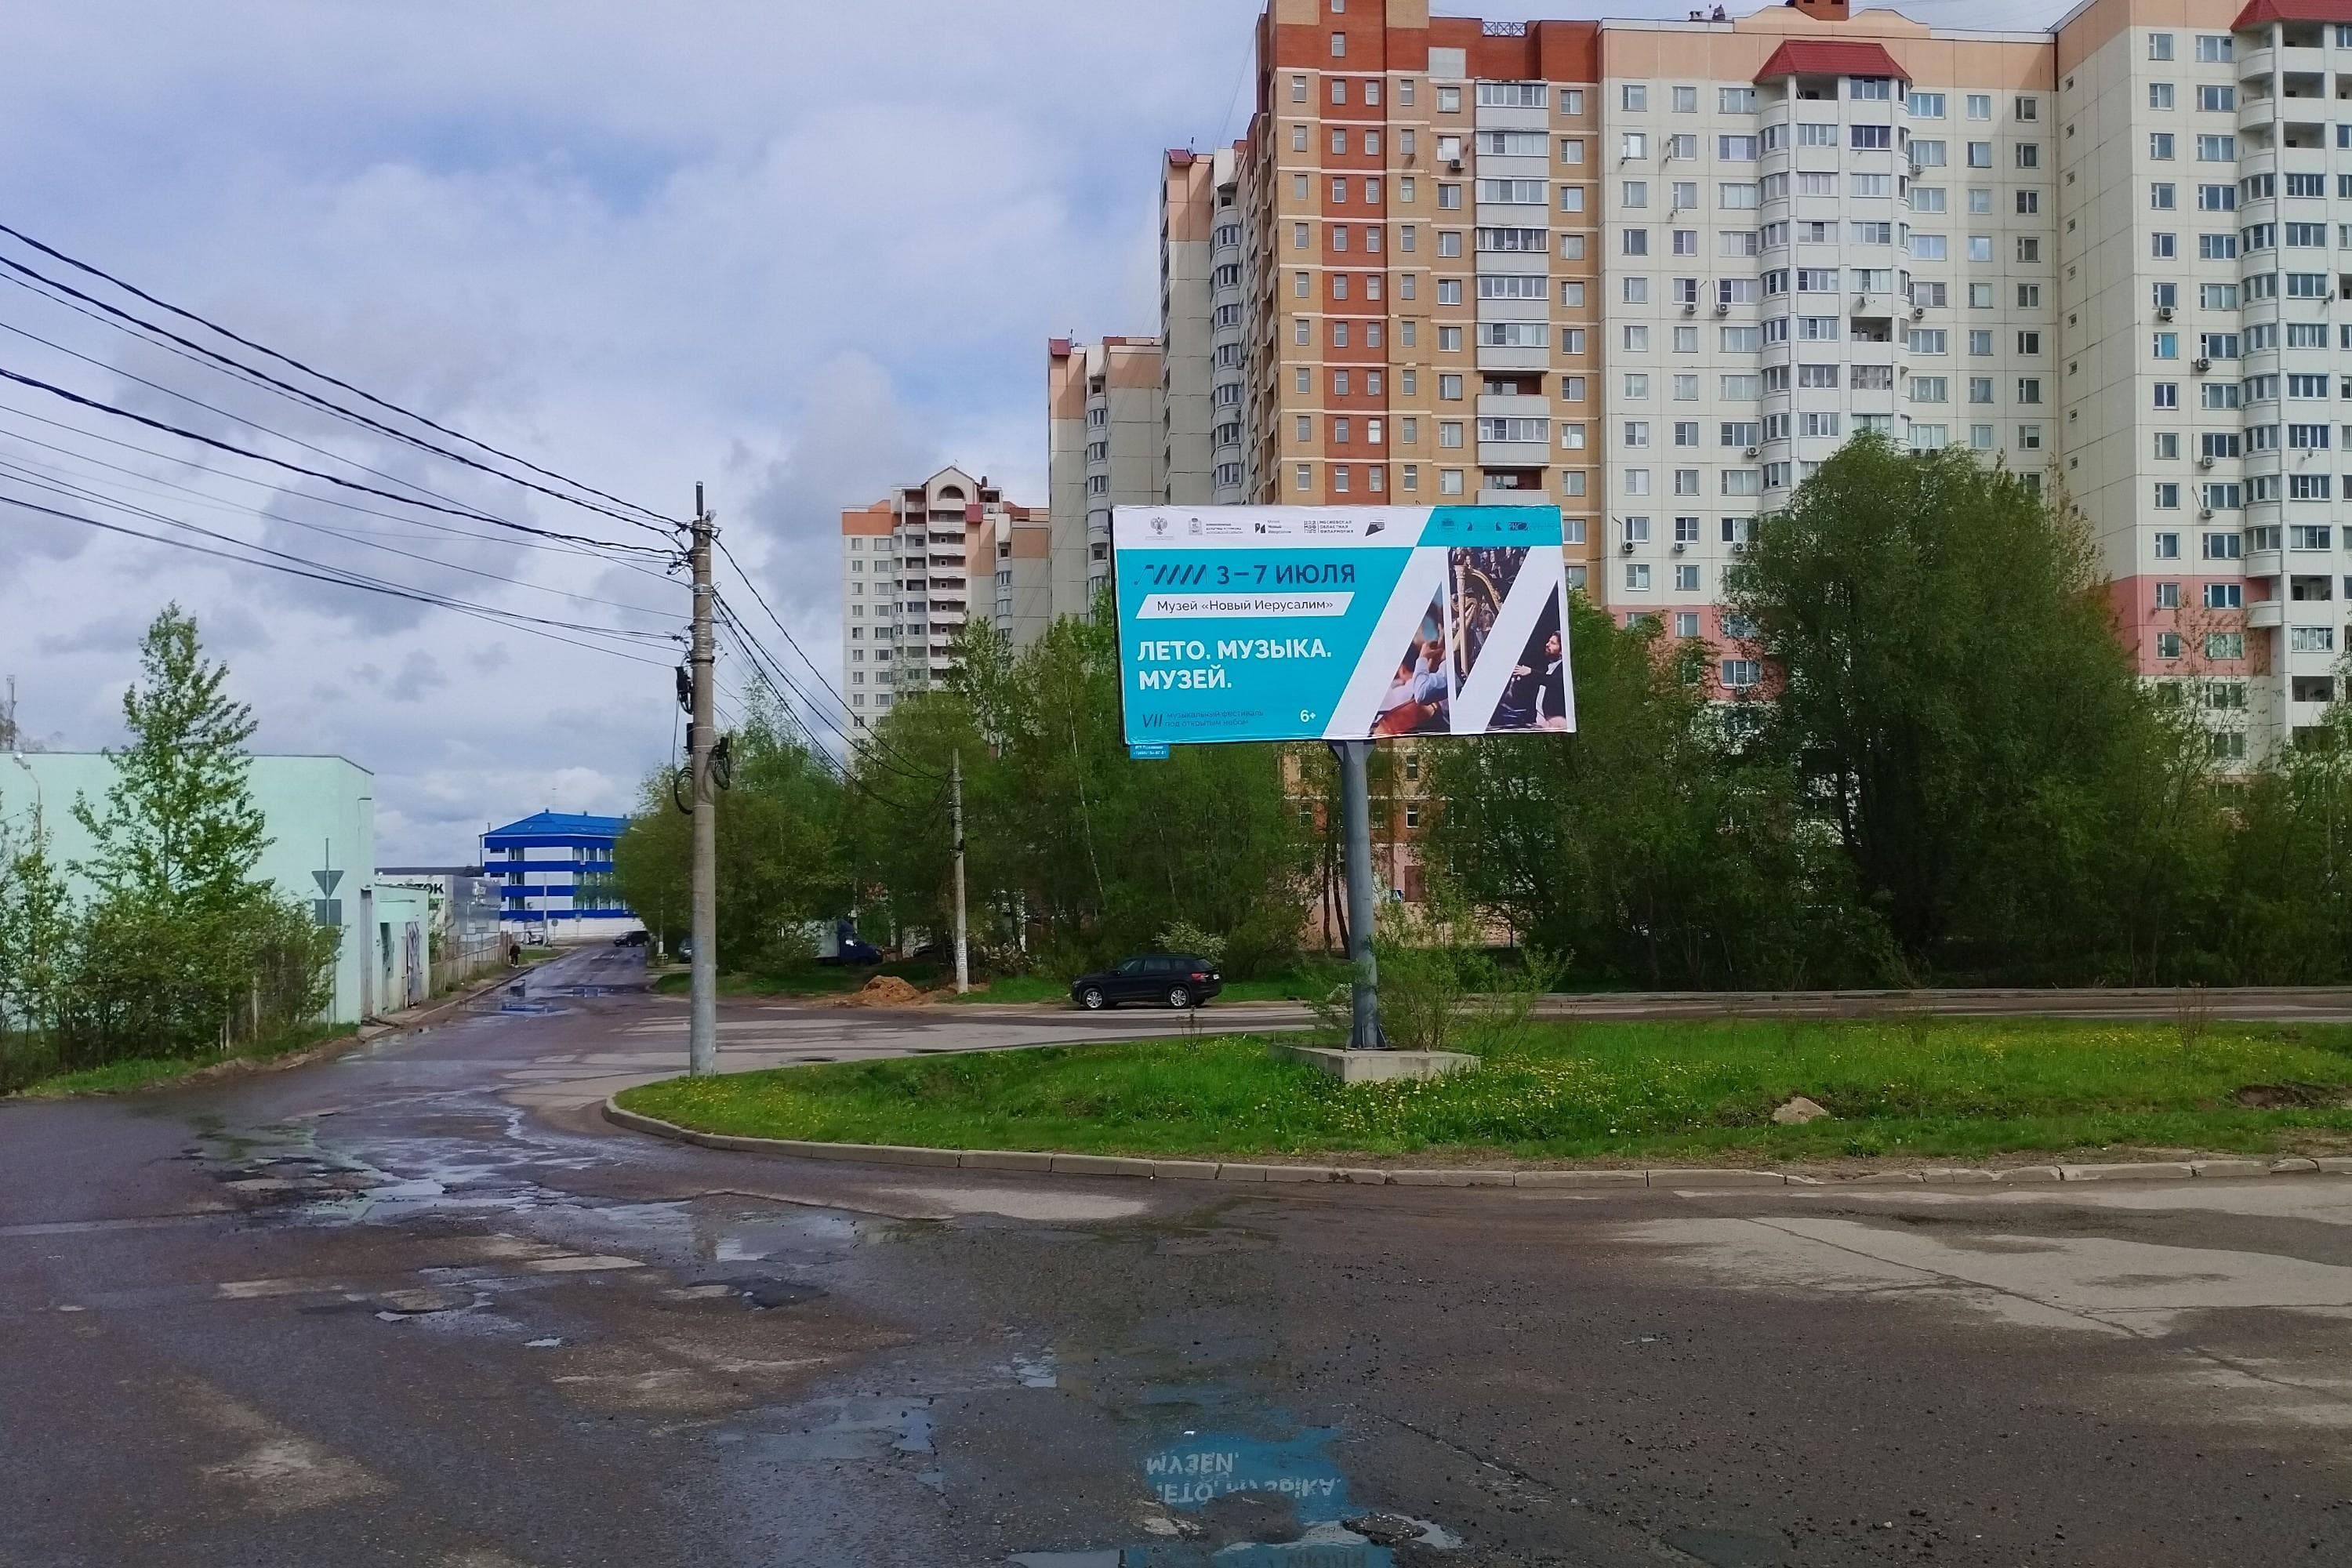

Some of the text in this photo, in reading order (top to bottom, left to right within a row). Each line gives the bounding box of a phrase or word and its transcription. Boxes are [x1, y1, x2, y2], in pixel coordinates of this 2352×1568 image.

[1276, 564, 1356, 585] ИЮЛЯ
[1157, 599, 1334, 614] Музей «Новый Иерусалим»
[1137, 638, 1332, 662] ЛЕТО. МУЗЫКА.
[1138, 663, 1232, 691] МУЗЕЙ.
[1142, 713, 1163, 728] VII
[1166, 710, 1264, 720] музыкальный фестиваль
[1299, 709, 1316, 723] 6+
